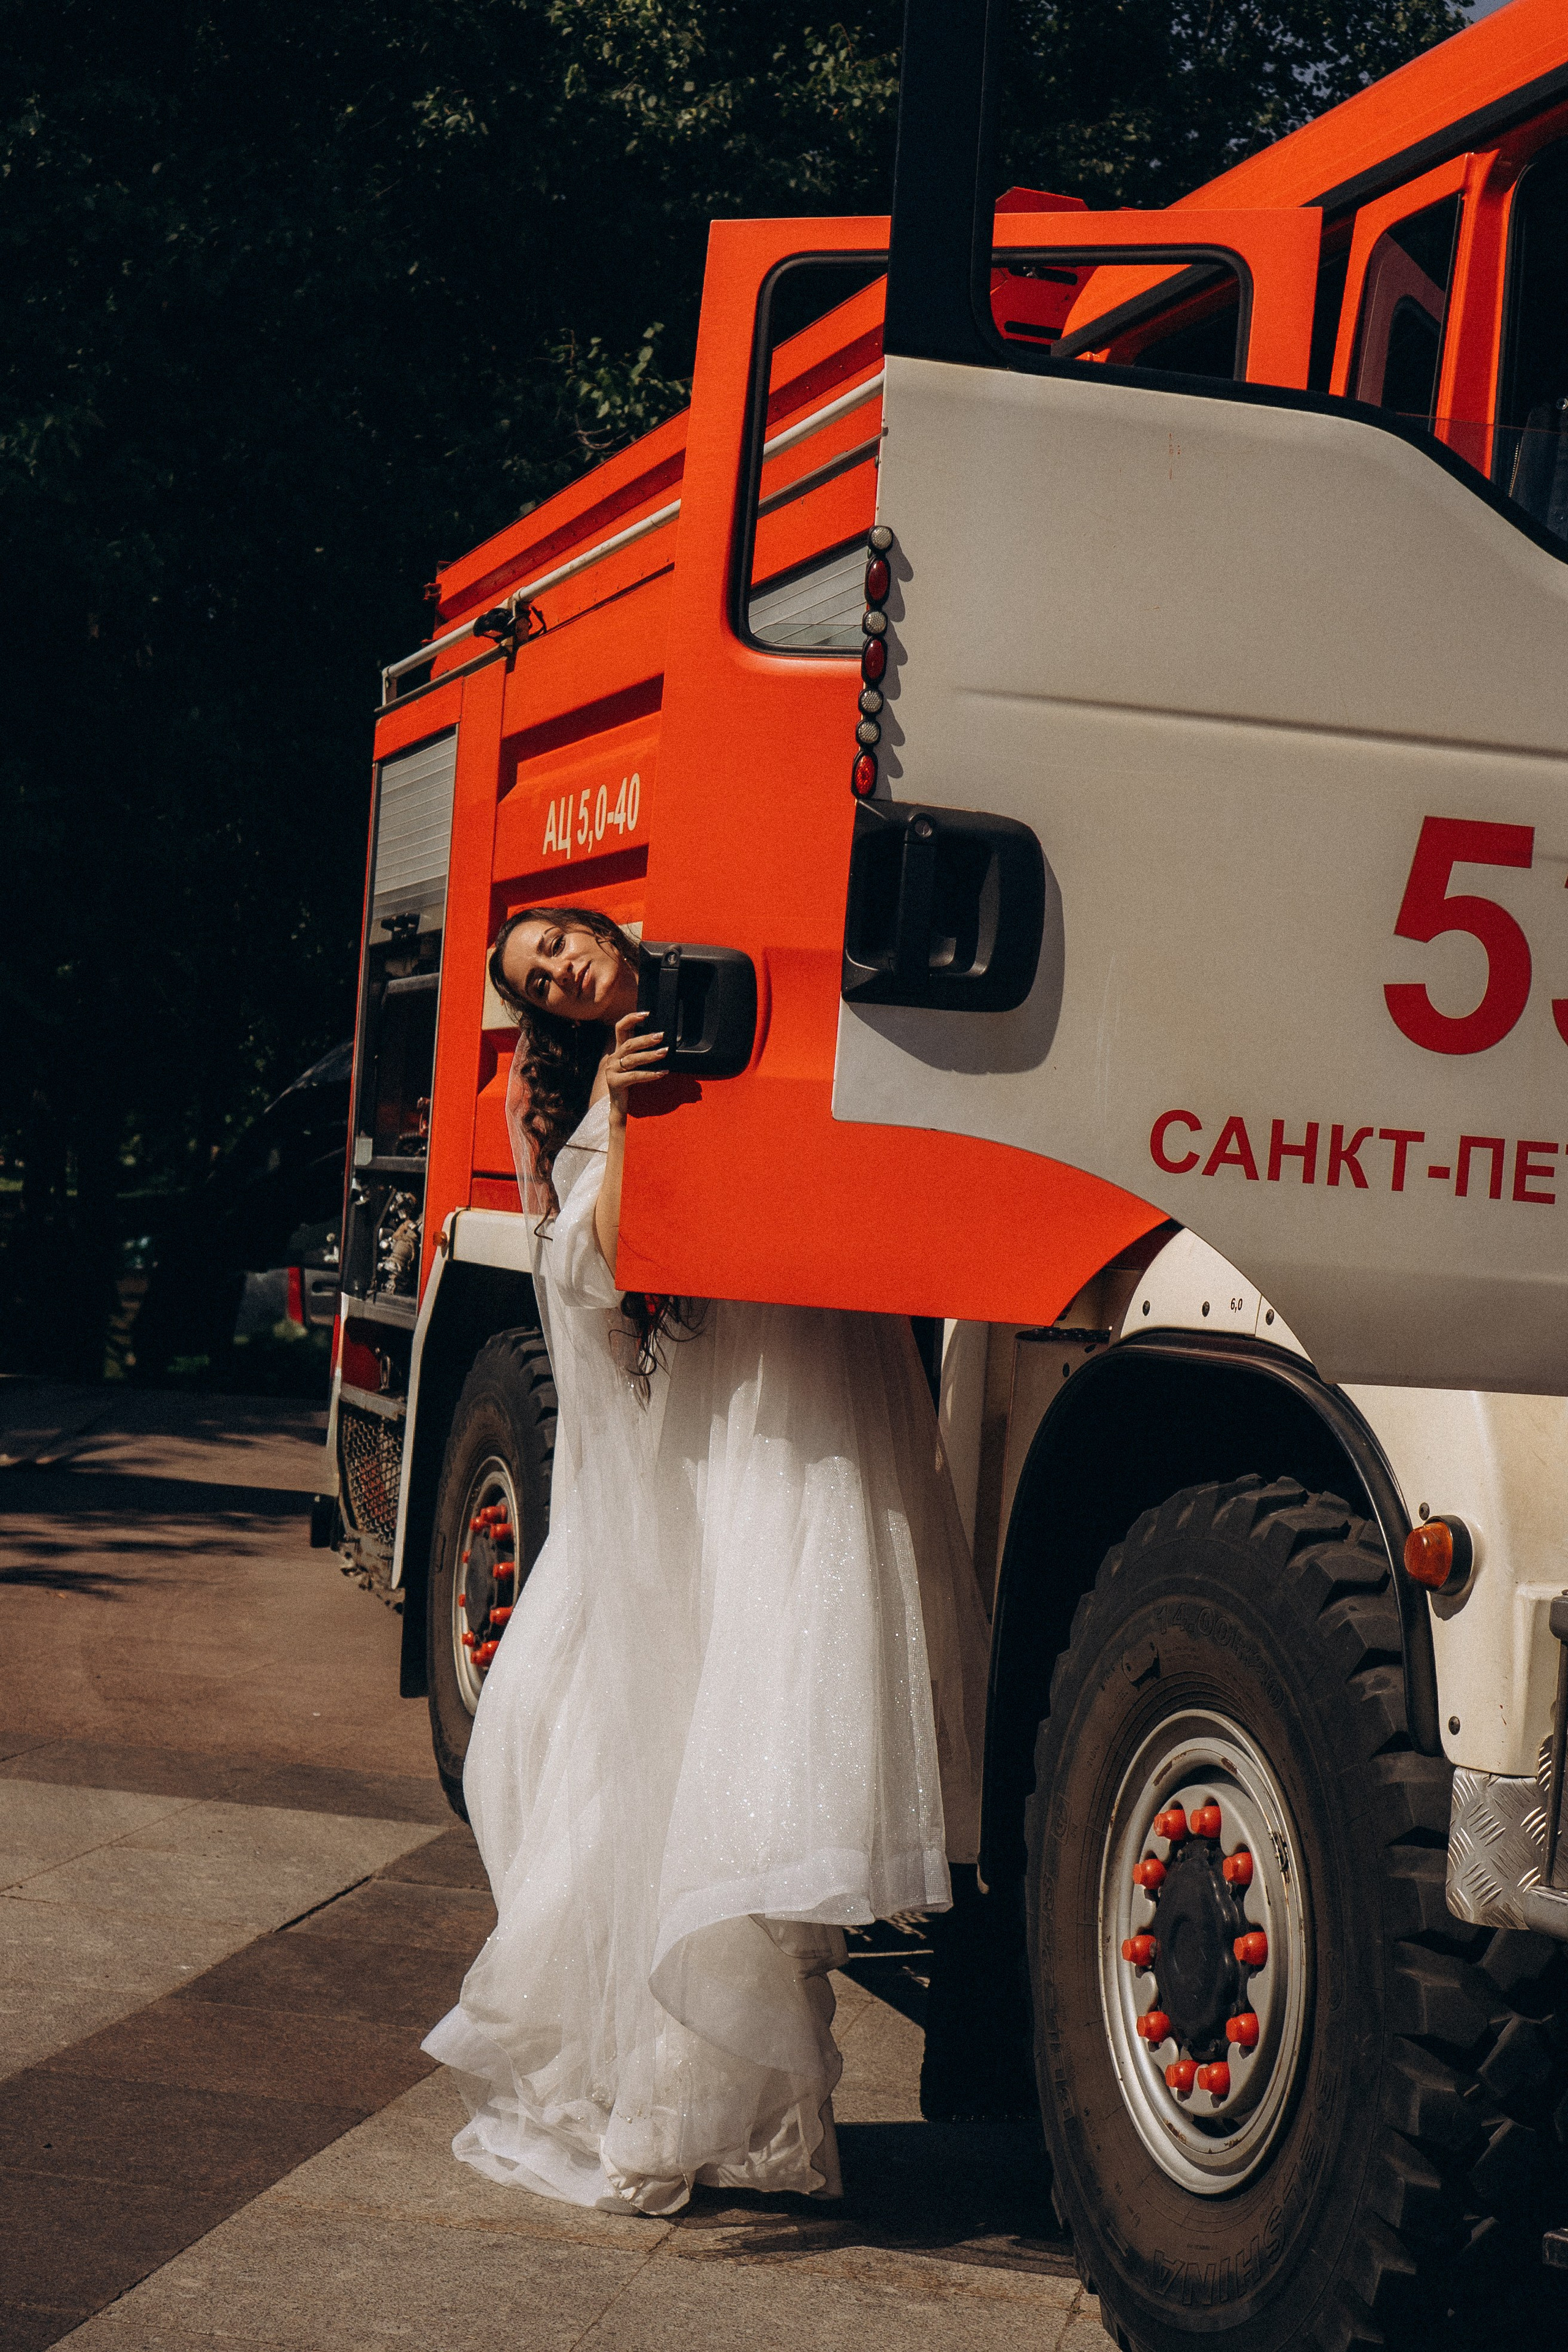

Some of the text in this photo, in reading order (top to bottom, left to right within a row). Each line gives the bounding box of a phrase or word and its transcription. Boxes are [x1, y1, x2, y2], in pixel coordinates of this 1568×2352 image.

[542, 772, 640, 859] АЦ 5,0-40
[1384, 815, 1568, 1055] 5
[1150, 1109, 1568, 1204] САНКТ-ПЕ
[1231, 1297, 1243, 1313] 6,0
